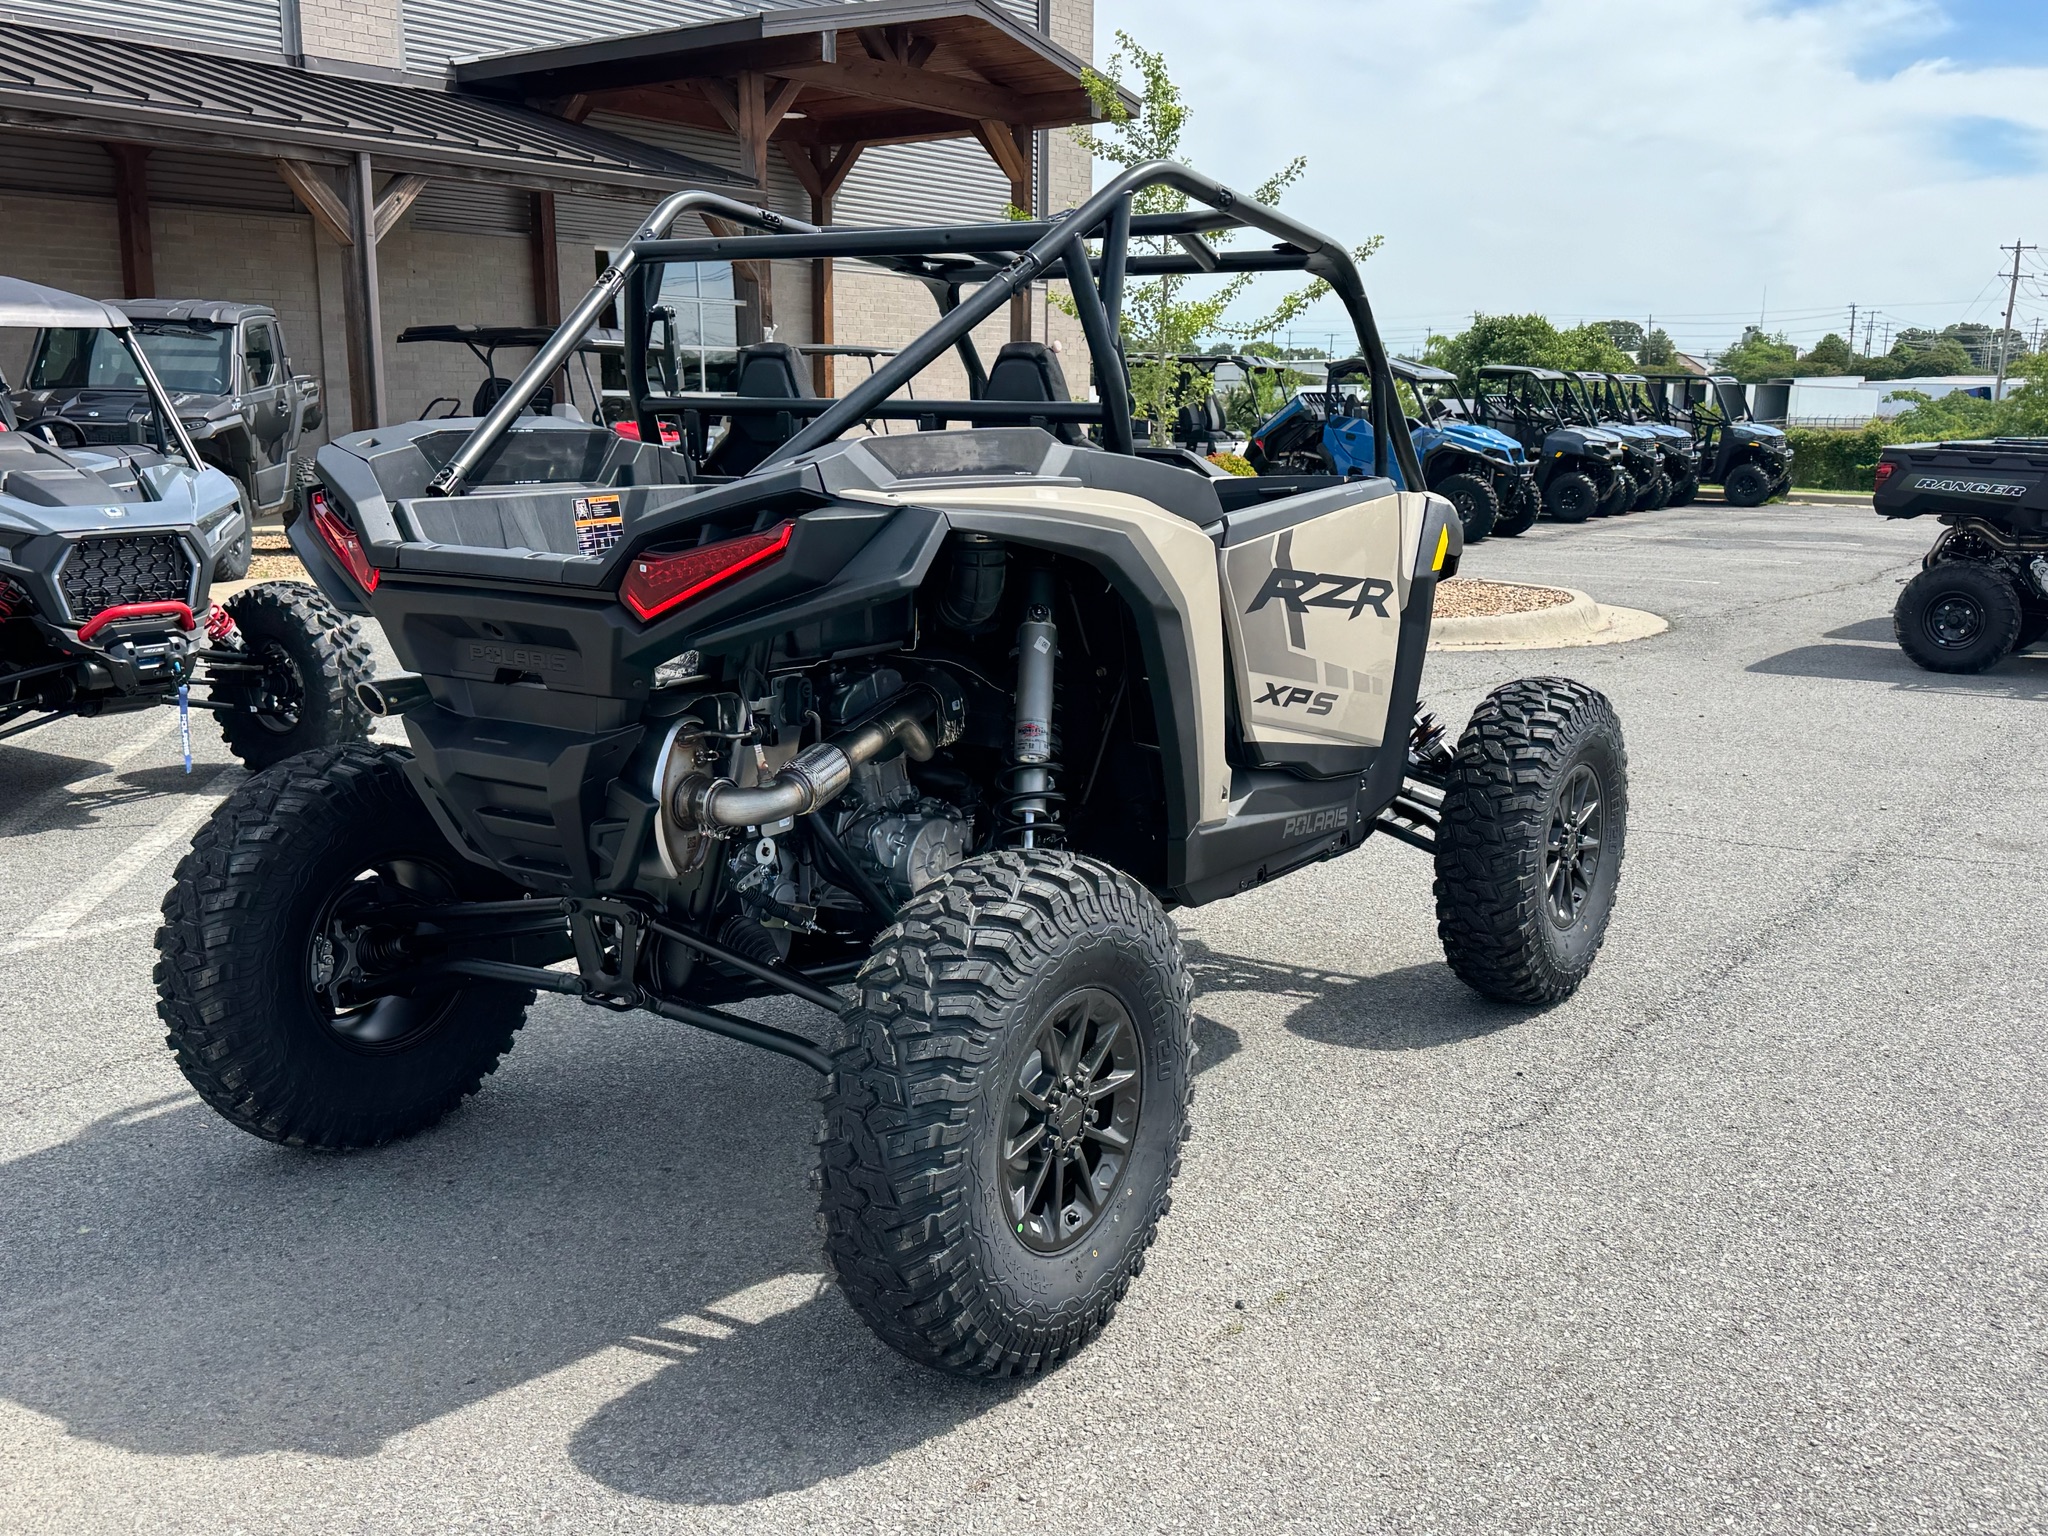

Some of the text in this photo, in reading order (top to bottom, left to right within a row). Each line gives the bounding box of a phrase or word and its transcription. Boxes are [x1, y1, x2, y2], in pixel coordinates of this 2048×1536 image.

[1914, 478, 2027, 497] RANGER
[1245, 567, 1394, 621] RZR
[469, 643, 567, 673] POLARIS
[1253, 682, 1339, 716] XPS
[181, 713, 190, 756] POLARIS
[1283, 807, 1348, 838] POLARIS
